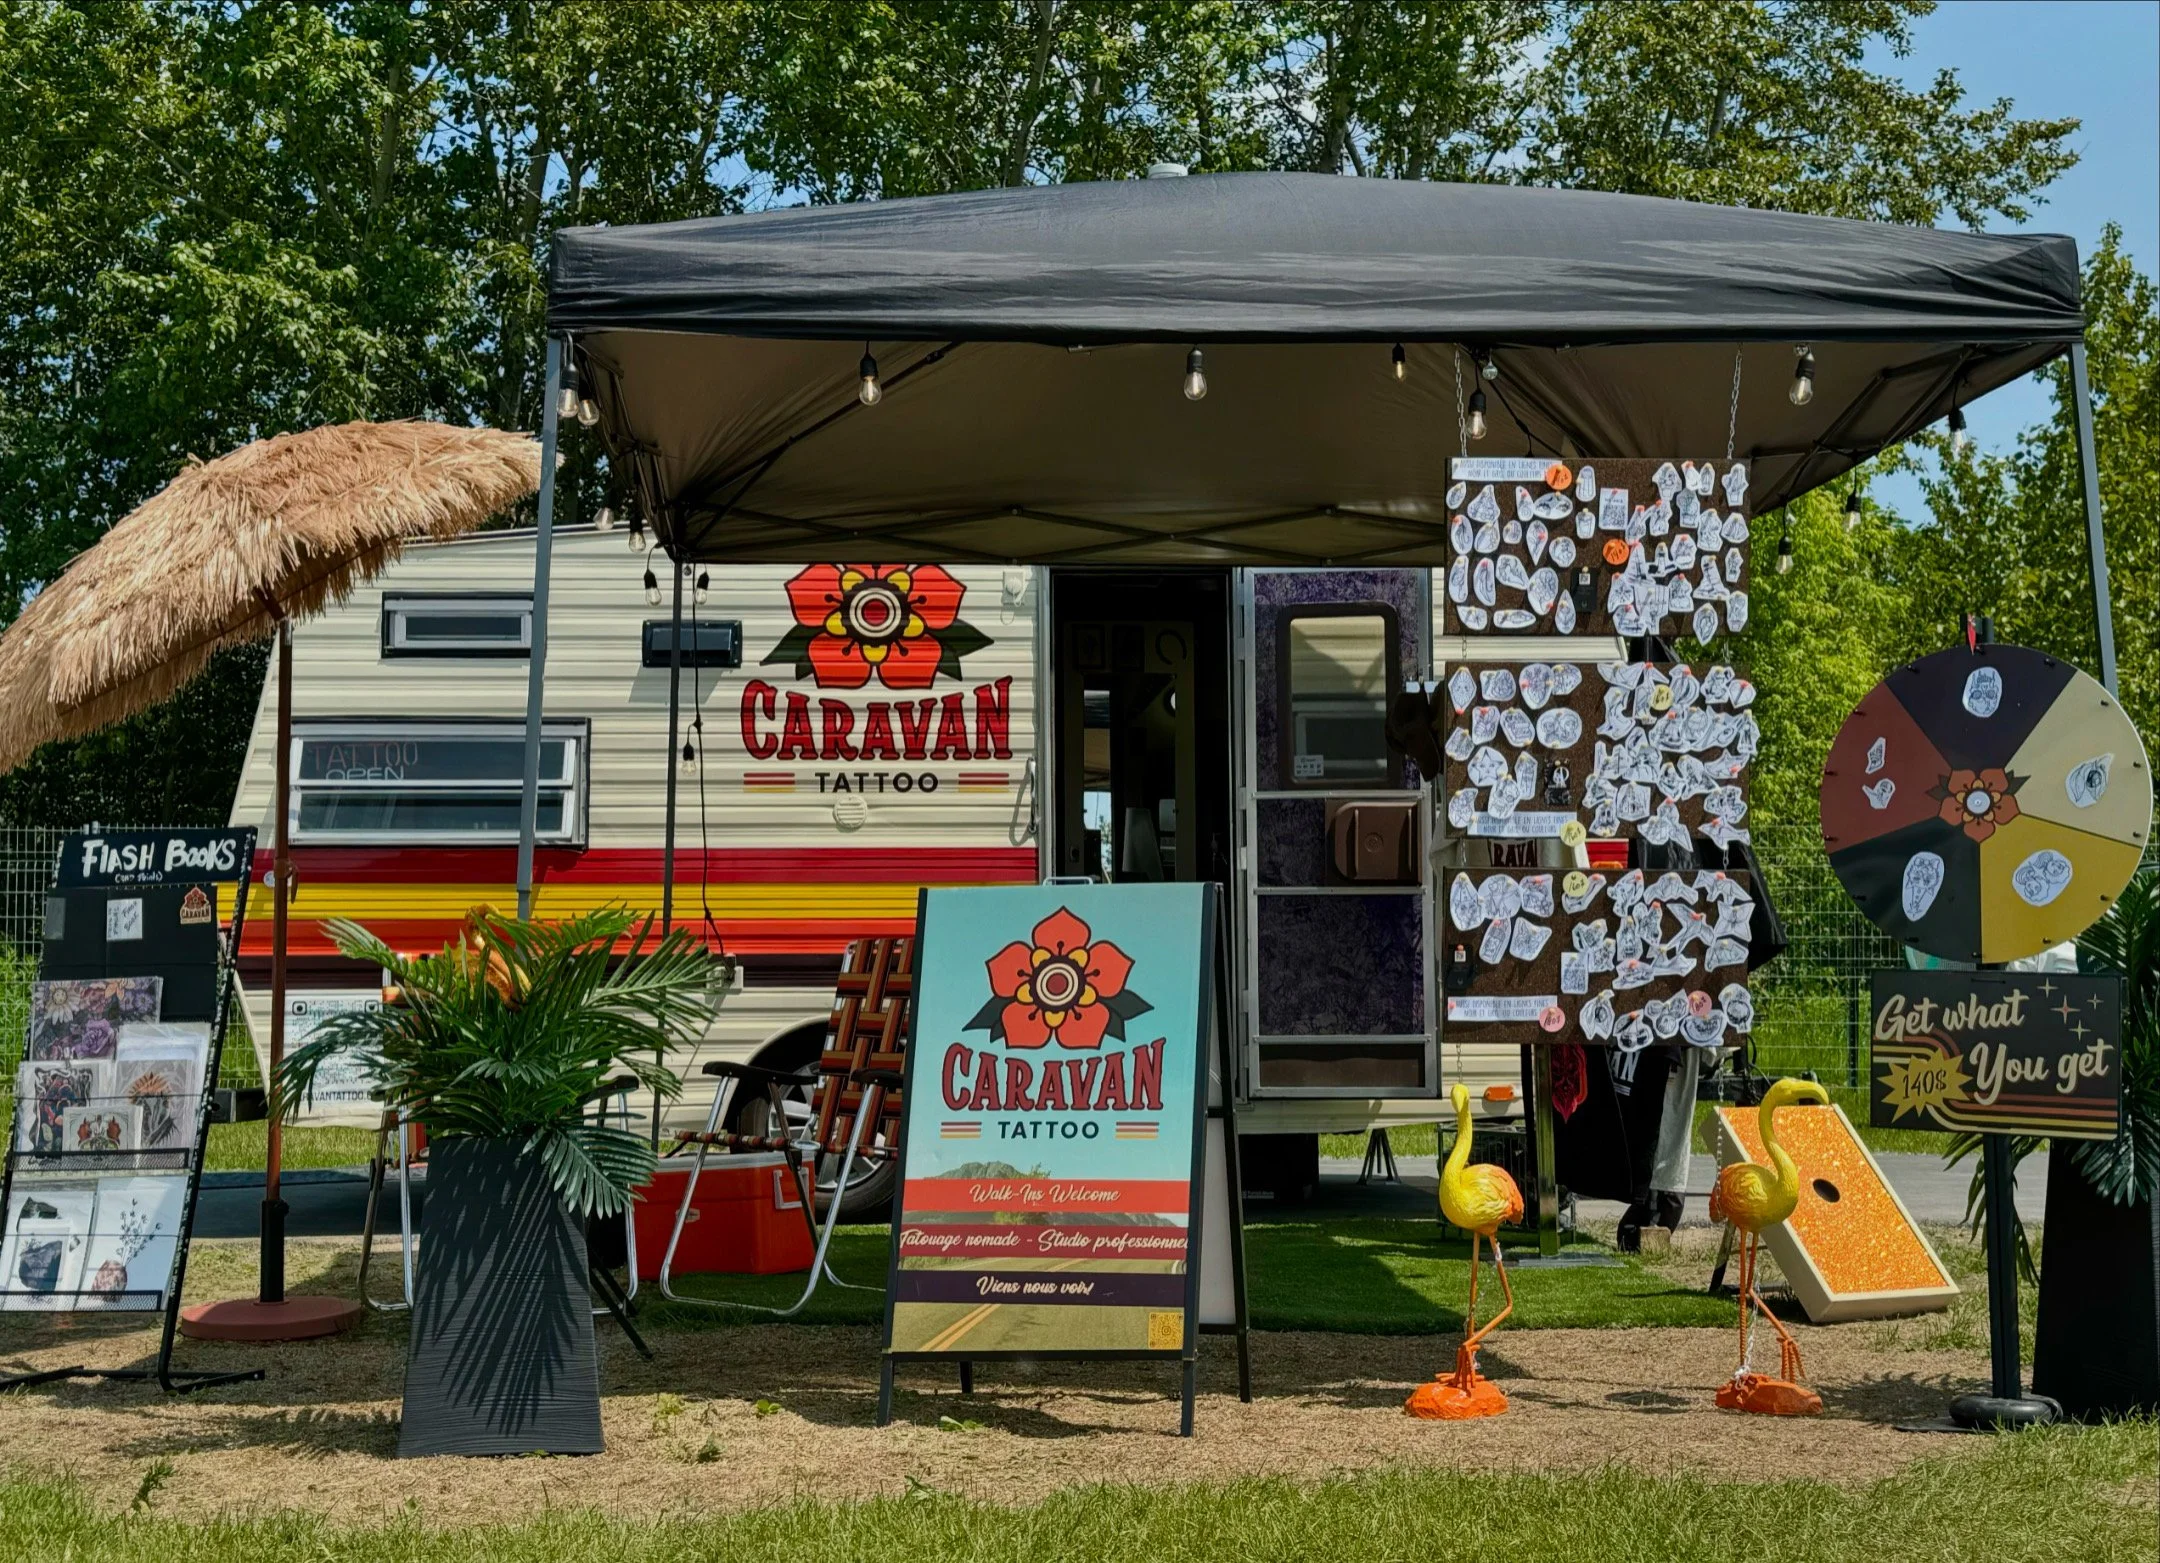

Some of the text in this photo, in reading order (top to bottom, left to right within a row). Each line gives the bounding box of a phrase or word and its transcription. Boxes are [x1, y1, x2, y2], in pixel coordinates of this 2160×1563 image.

[740, 675, 1013, 761] CARAVAN
[312, 740, 419, 771] TATTOO
[325, 765, 404, 780] OPEN
[815, 772, 939, 793] TATTOO
[1875, 988, 2029, 1042] Get what
[941, 1037, 1166, 1112] CARAVAN
[1903, 1069, 1947, 1099] 140$
[1969, 1038, 2114, 1106] You get
[998, 1121, 1100, 1139] TATTOO
[969, 1183, 1121, 1204] Walk-Ins Welcome
[900, 1229, 962, 1252] Tatouage
[965, 1231, 1021, 1247] nomade
[1037, 1229, 1092, 1252] Studio
[976, 1276, 1021, 1296] Viens
[1023, 1281, 1057, 1294] nous
